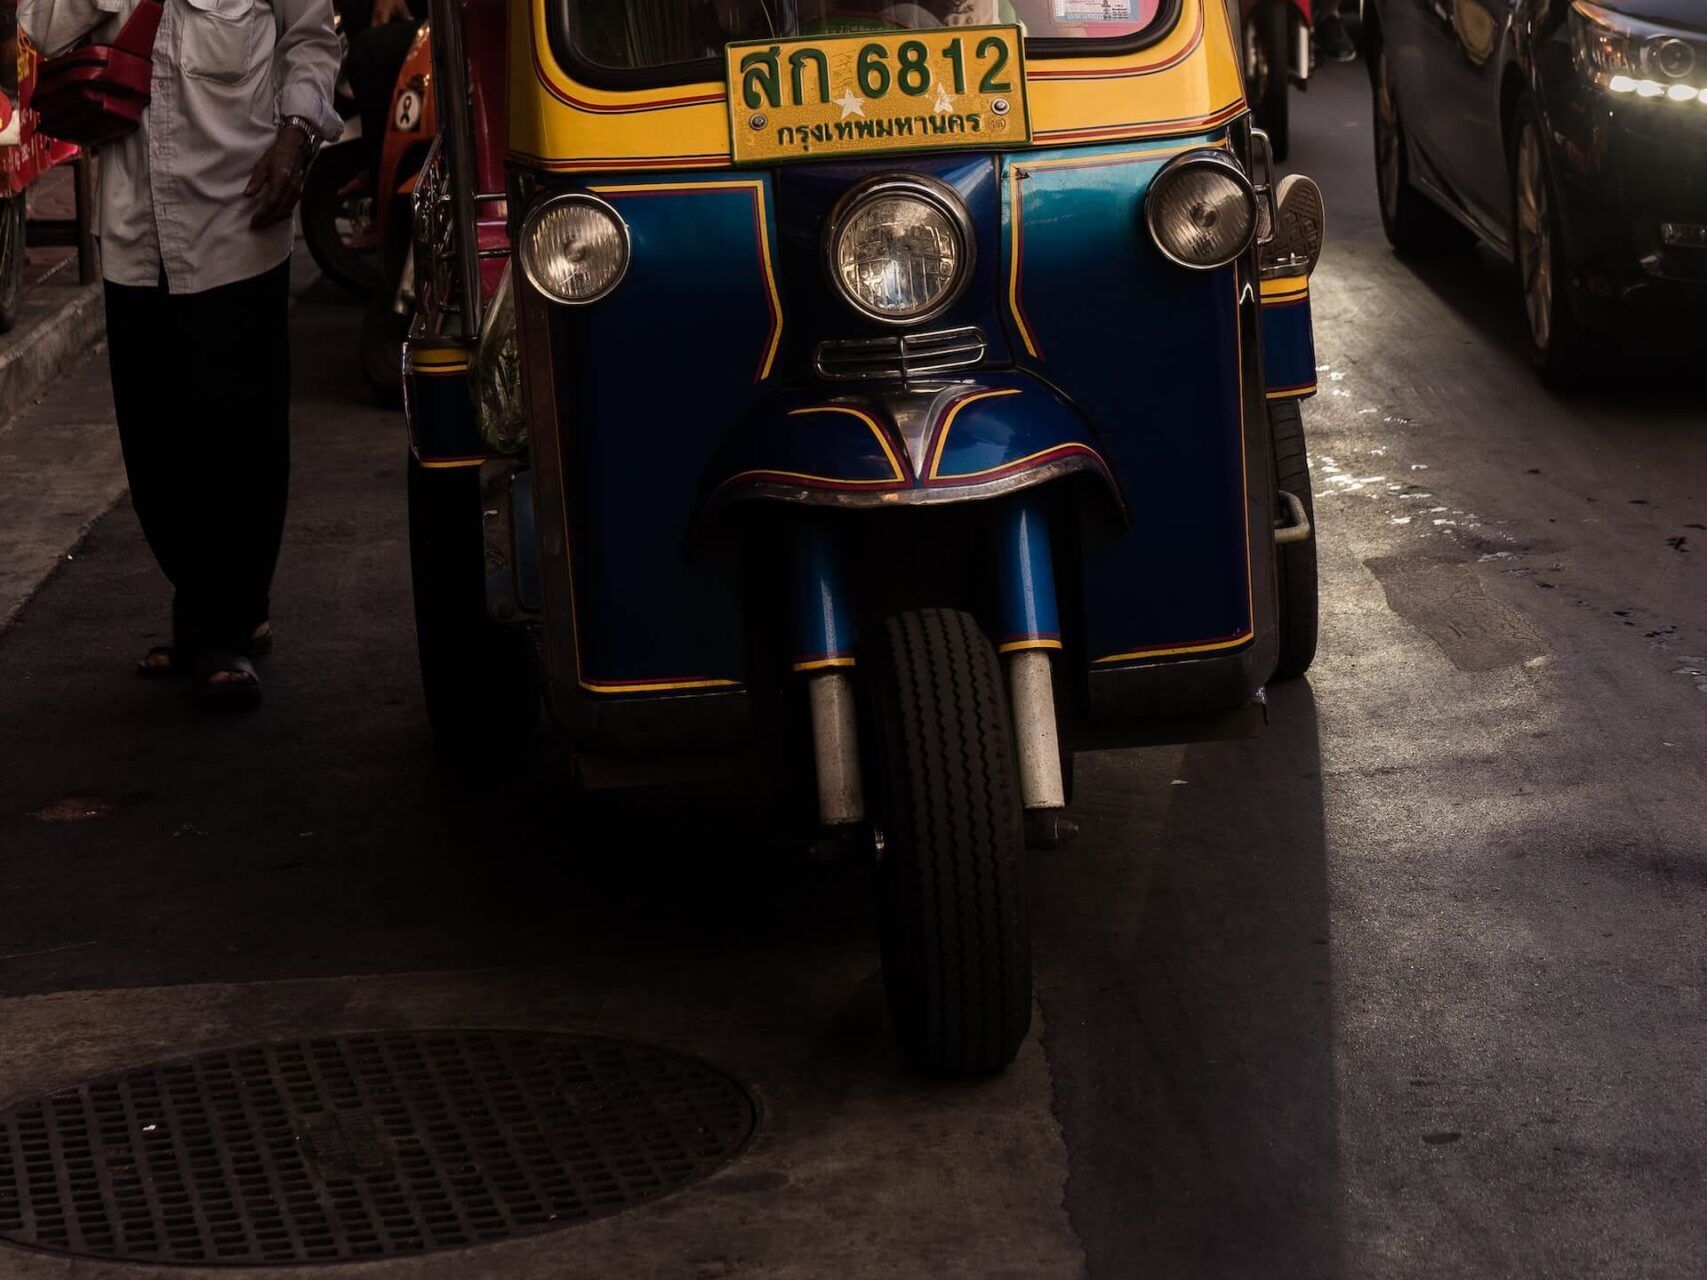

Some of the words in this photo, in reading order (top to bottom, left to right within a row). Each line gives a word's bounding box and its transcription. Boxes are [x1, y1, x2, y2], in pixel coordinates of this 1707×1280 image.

[740, 46, 832, 109] สก
[856, 36, 1012, 99] 6812
[777, 111, 982, 151] กรุงเทพมหานคร
